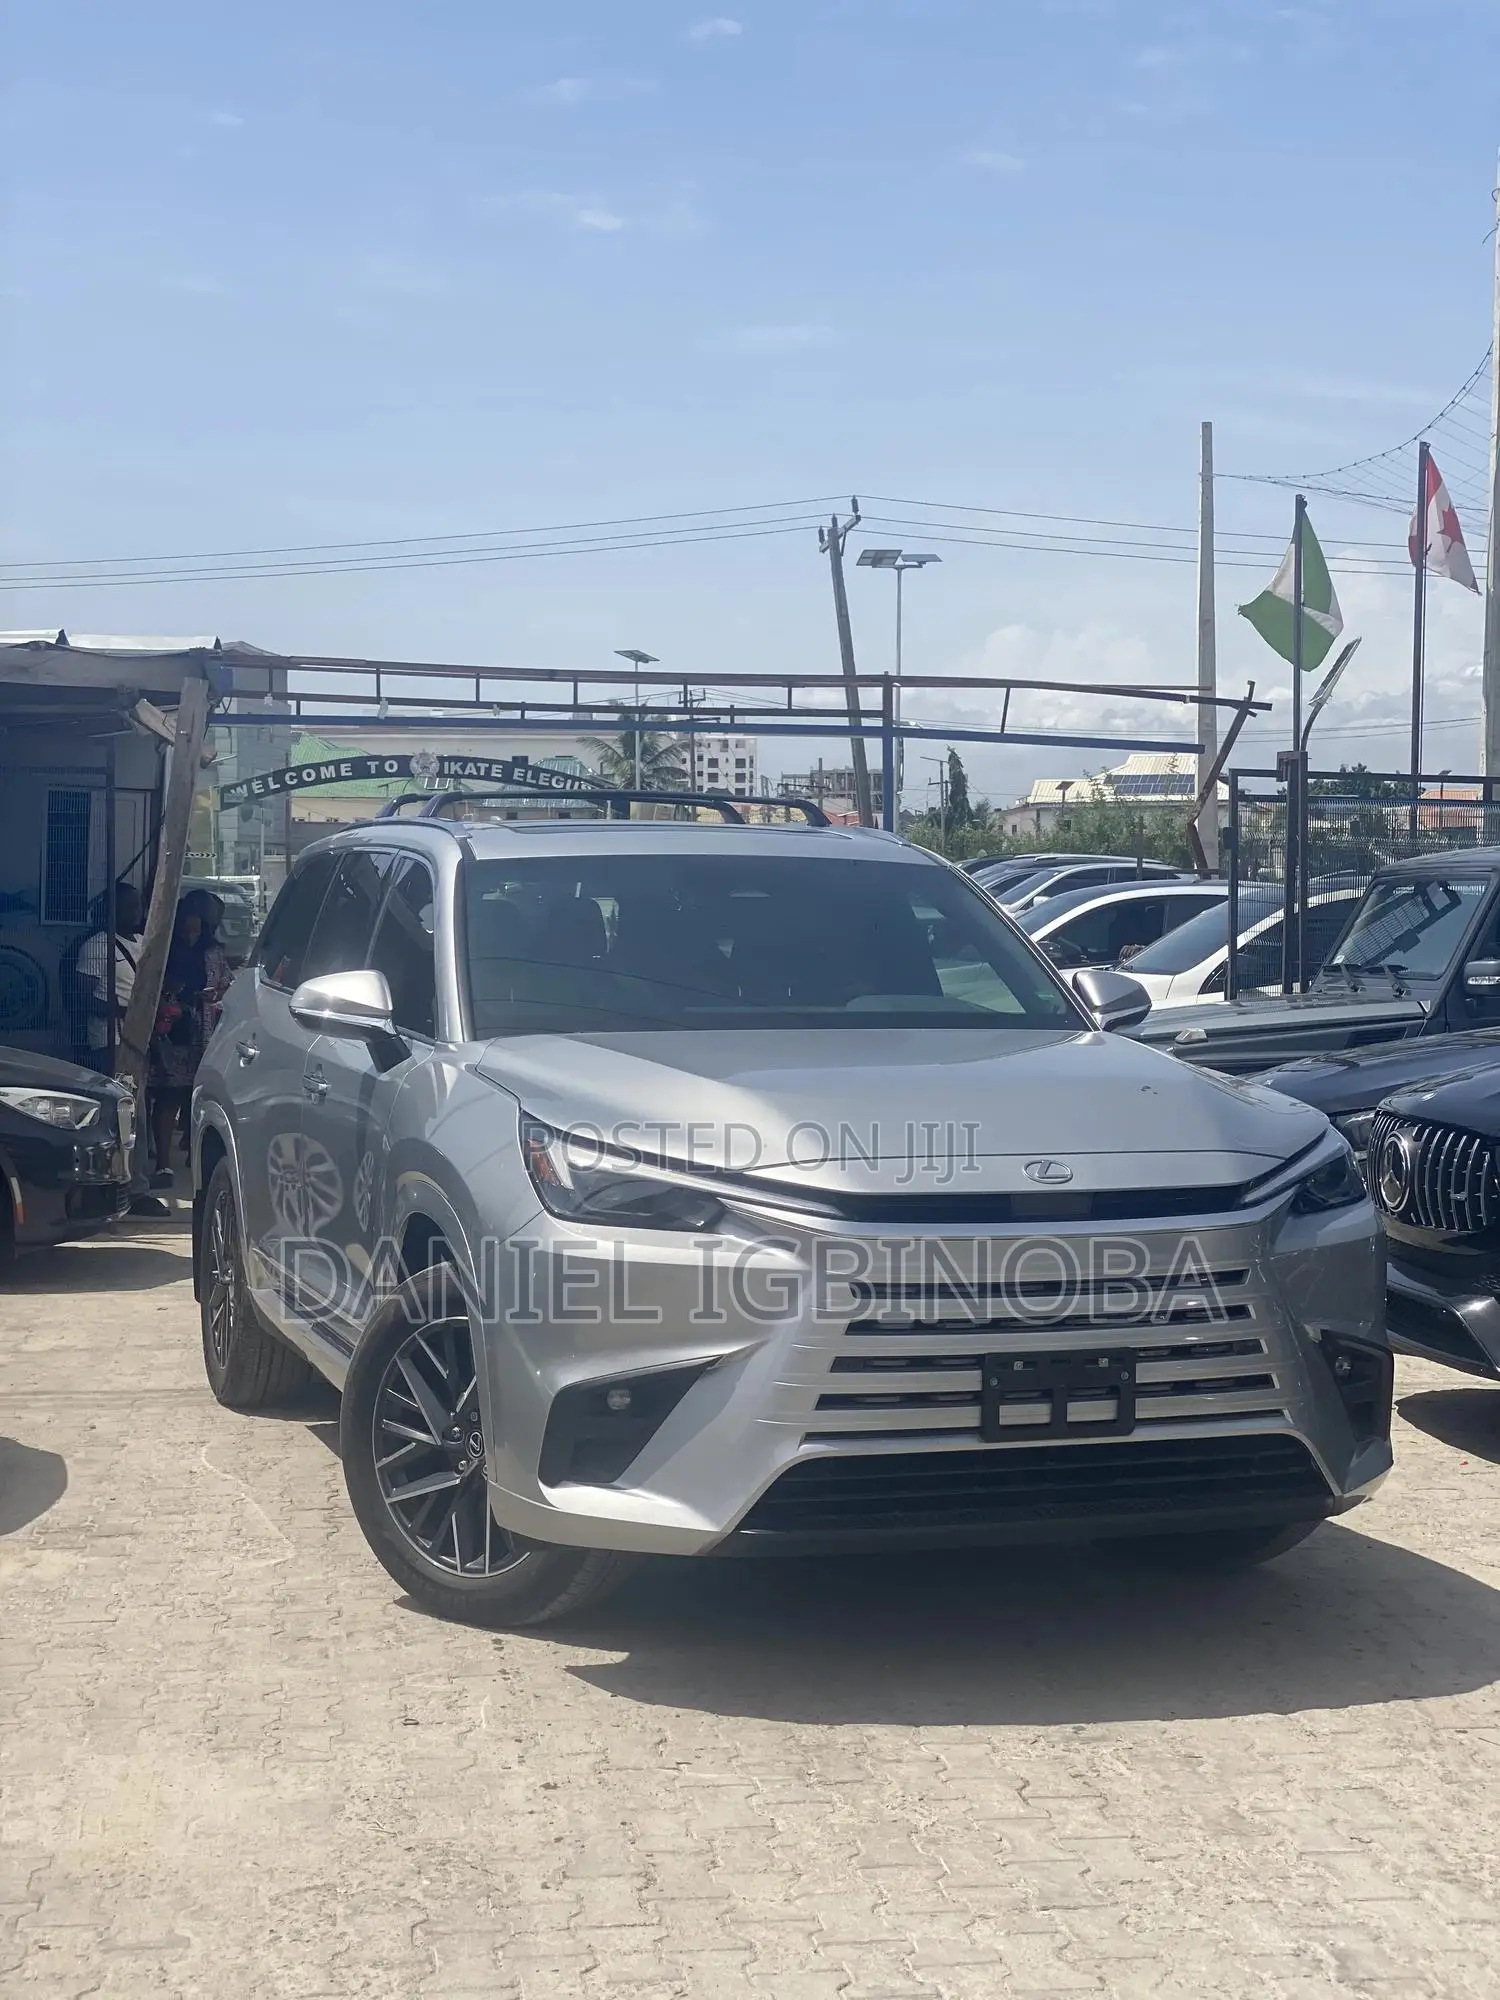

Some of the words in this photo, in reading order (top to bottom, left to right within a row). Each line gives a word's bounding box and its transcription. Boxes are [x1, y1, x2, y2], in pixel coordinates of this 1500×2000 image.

[230, 763, 352, 798] WELCOME
[367, 760, 398, 774] TO
[443, 761, 503, 777] IKATE
